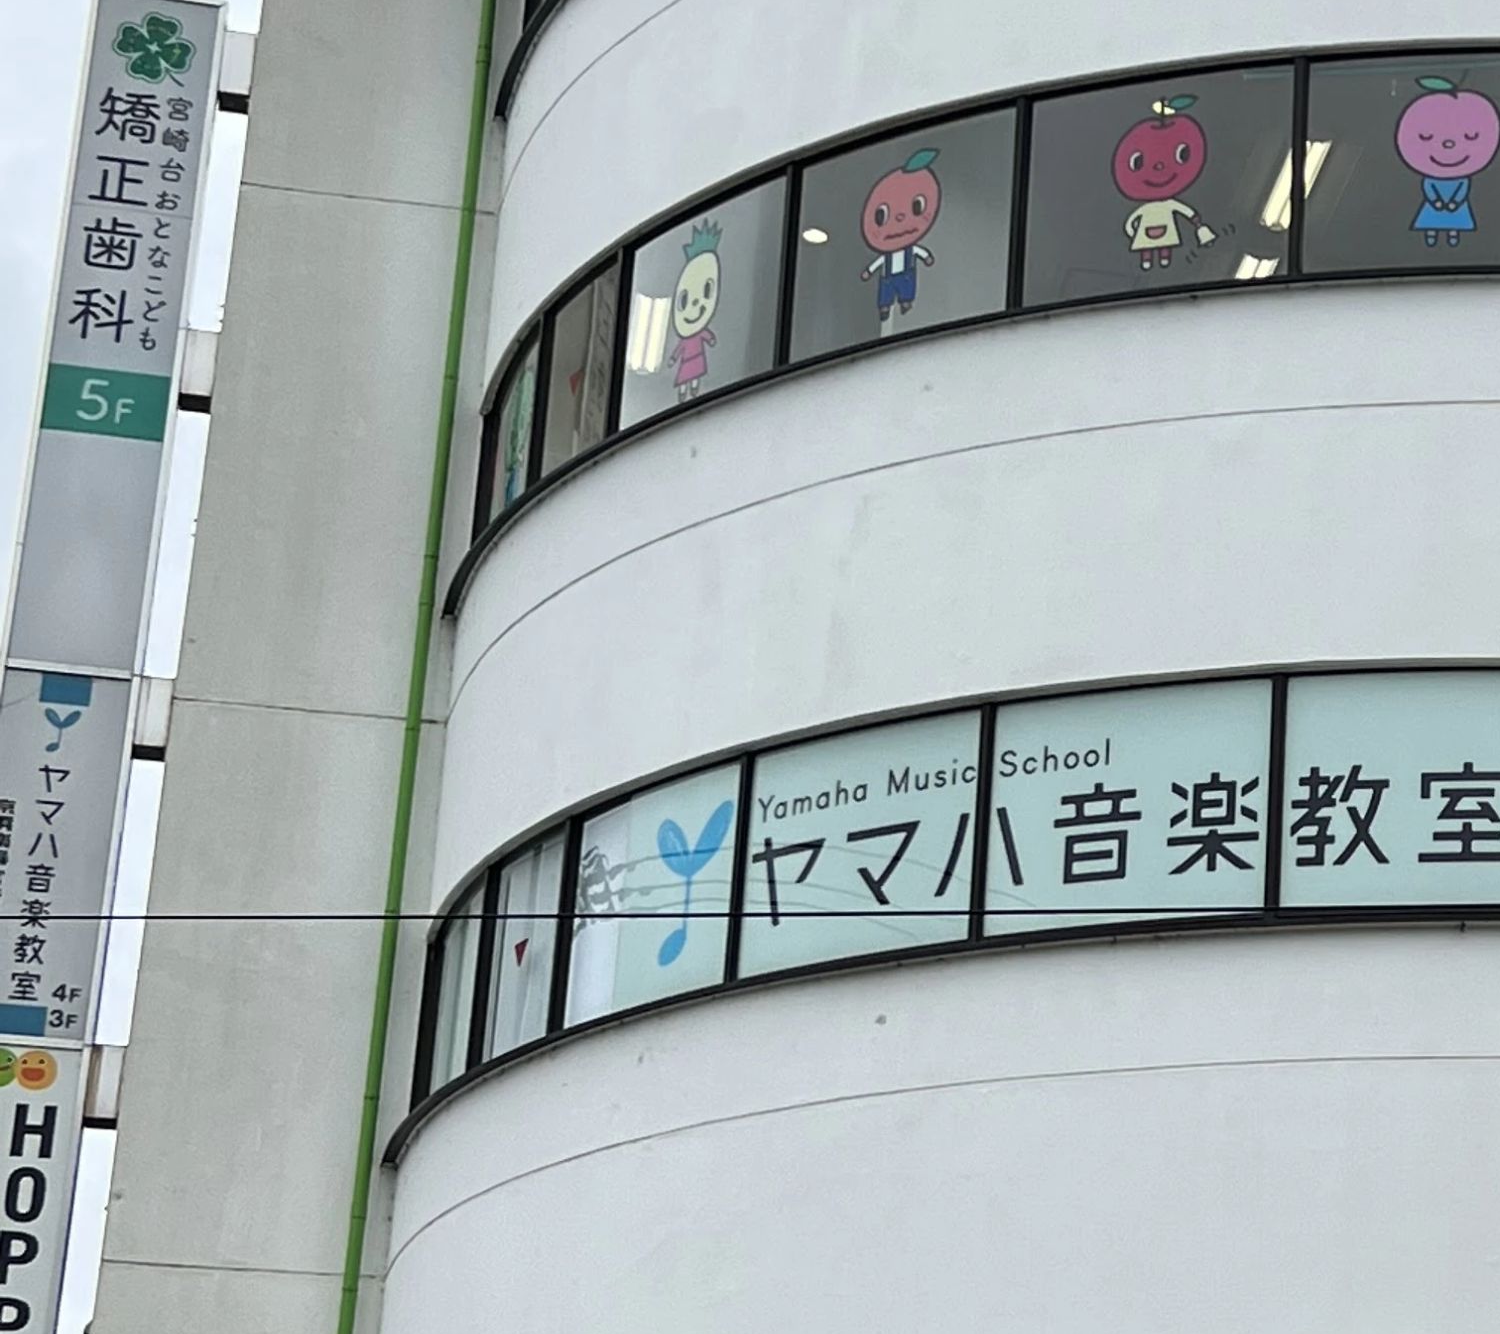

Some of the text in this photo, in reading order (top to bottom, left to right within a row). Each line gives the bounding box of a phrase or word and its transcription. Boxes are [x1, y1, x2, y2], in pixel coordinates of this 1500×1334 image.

[68, 86, 161, 344] 矯正歯科
[139, 96, 194, 351] 宮崎台おとなこども
[75, 378, 136, 424] 5F
[758, 738, 1111, 823] Yamaha Music School
[8, 764, 72, 1003] ヤマハ音楽教室
[48, 1009, 78, 1029] 3F
[51, 983, 82, 1003] 4F
